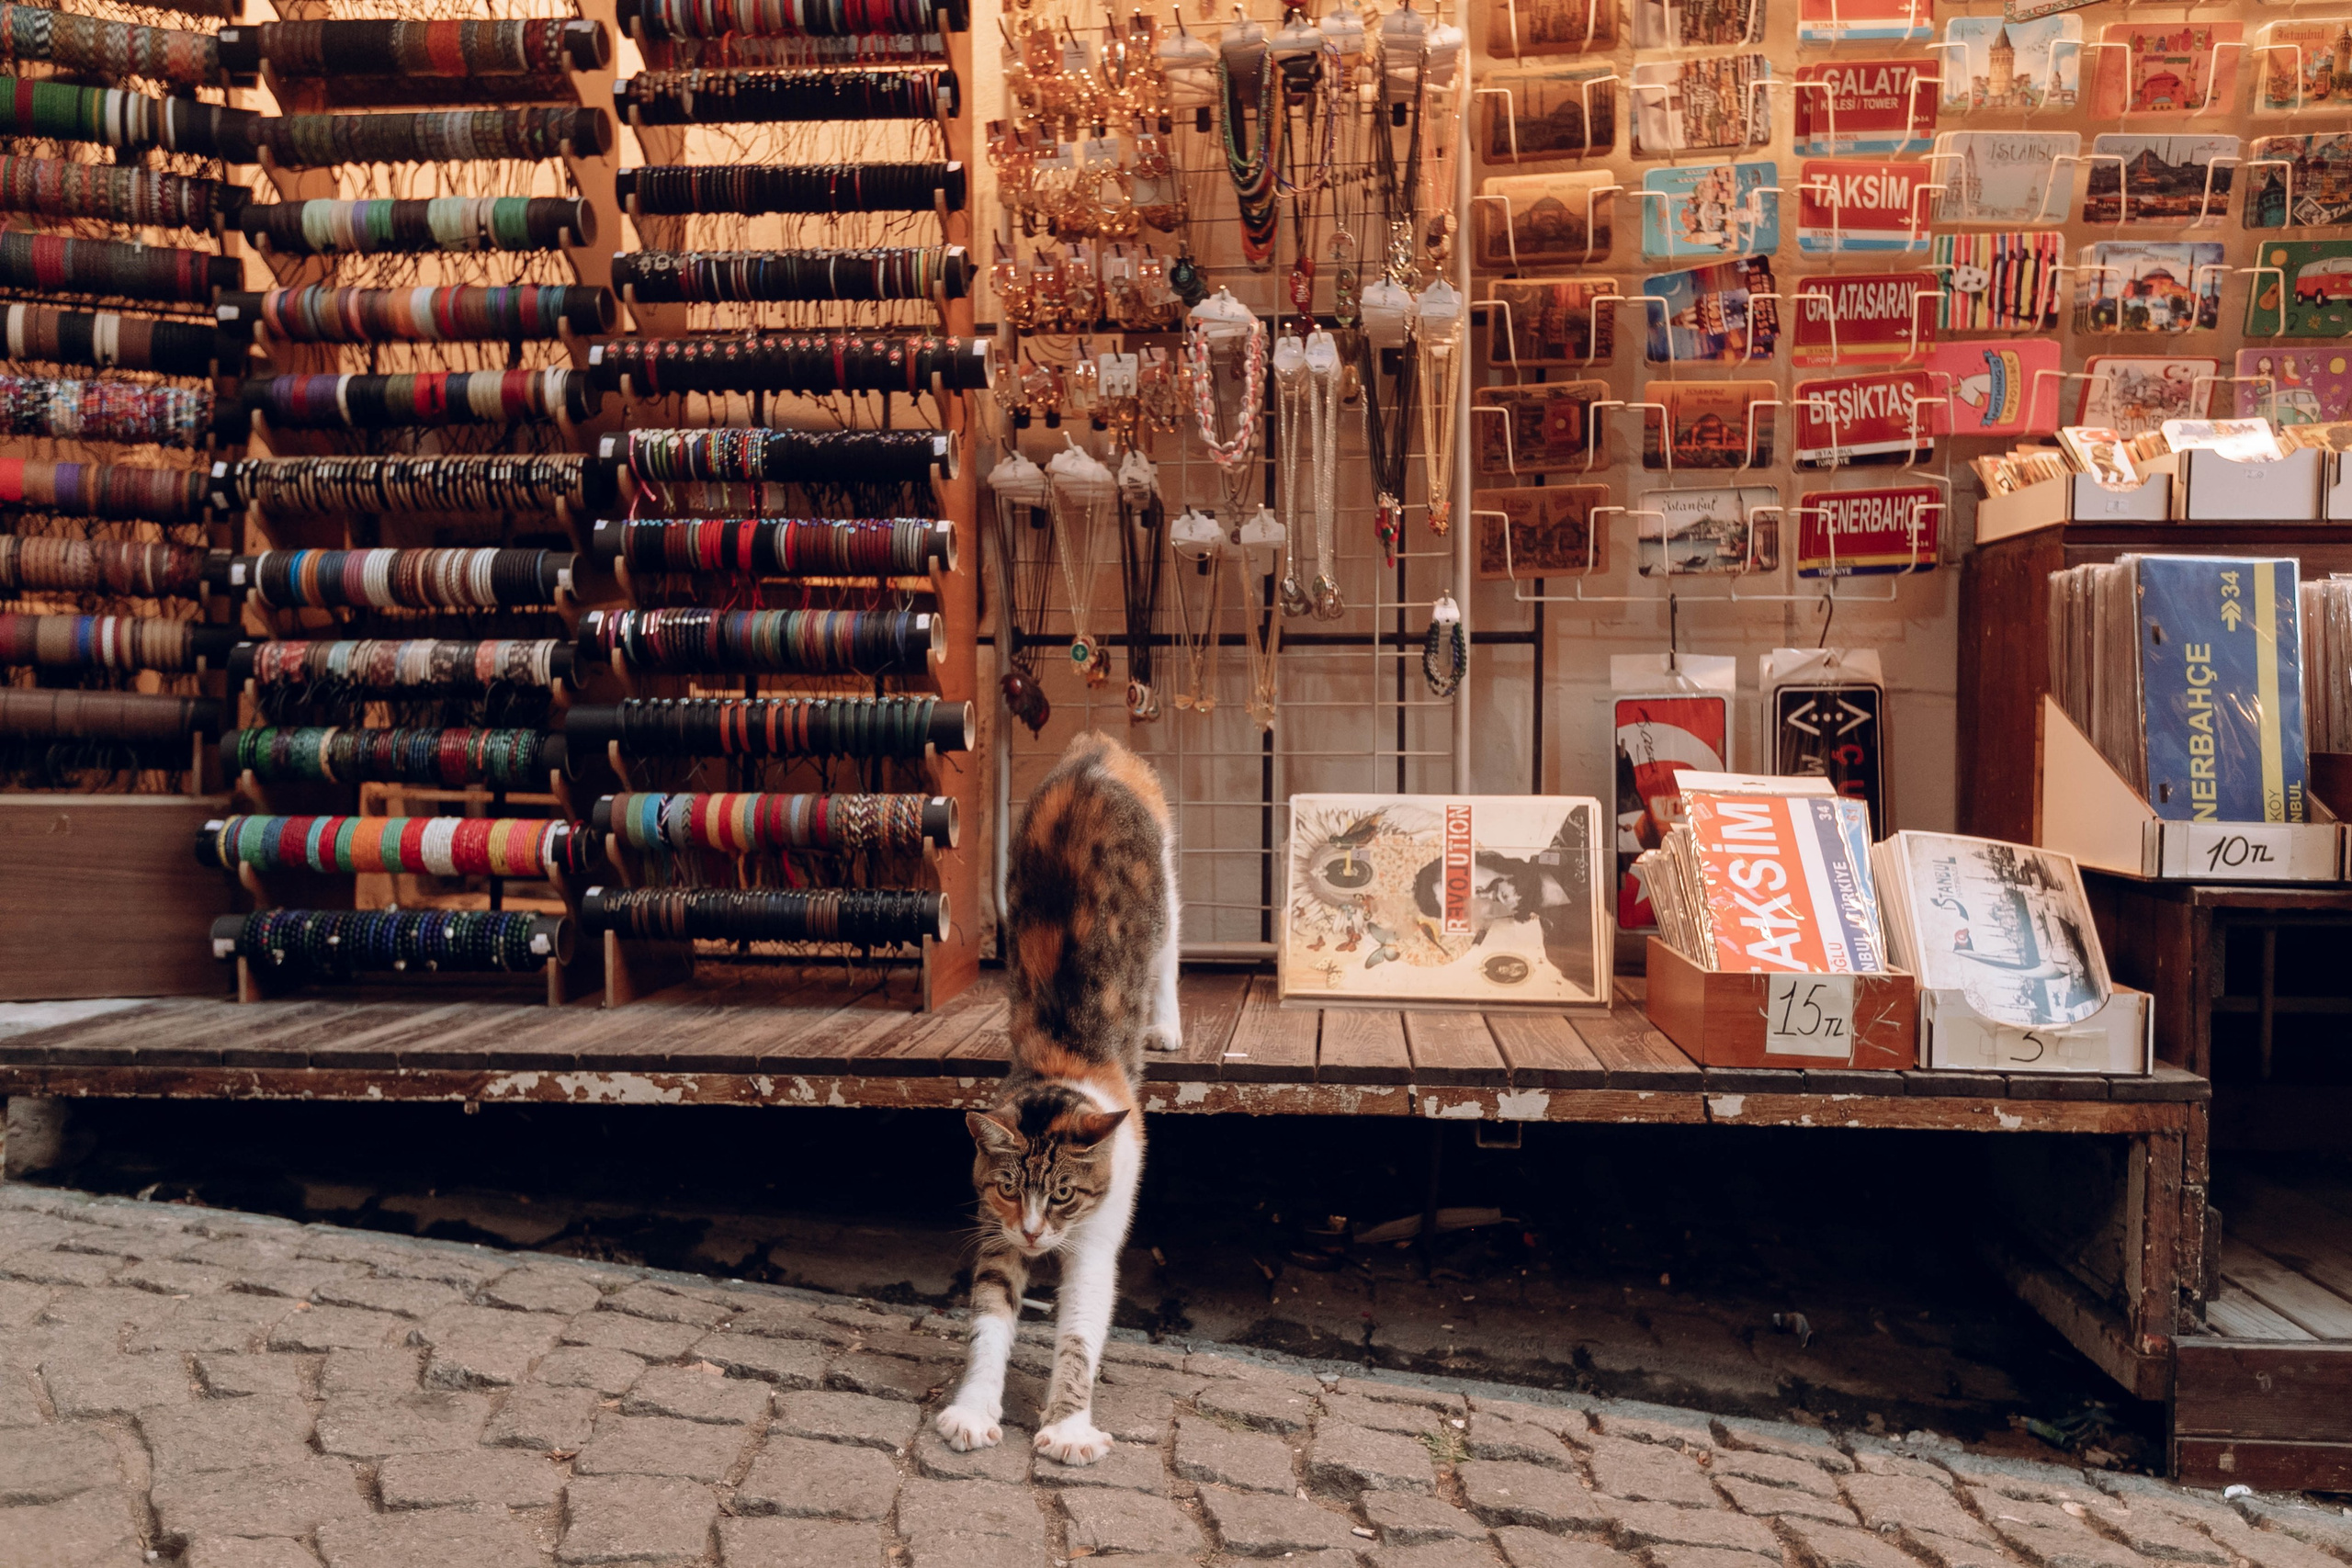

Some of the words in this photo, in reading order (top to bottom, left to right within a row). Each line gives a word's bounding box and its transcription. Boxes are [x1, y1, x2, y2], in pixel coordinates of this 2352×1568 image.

[1822, 67, 1922, 96] GALATA
[1820, 96, 1855, 110] KLESİ
[1863, 97, 1899, 110] TOWER
[1810, 167, 1909, 209] TAKSİM
[1805, 281, 1918, 322] GALATASARAY
[1808, 381, 1916, 430] BEŞİKTAŞ
[1817, 495, 1928, 540] FENERBAHÇE
[2221, 570, 2240, 597] 34
[2186, 643, 2218, 821] NERBAHÇE
[1816, 805, 1832, 821] 34
[1712, 802, 1810, 972] AKSİM
